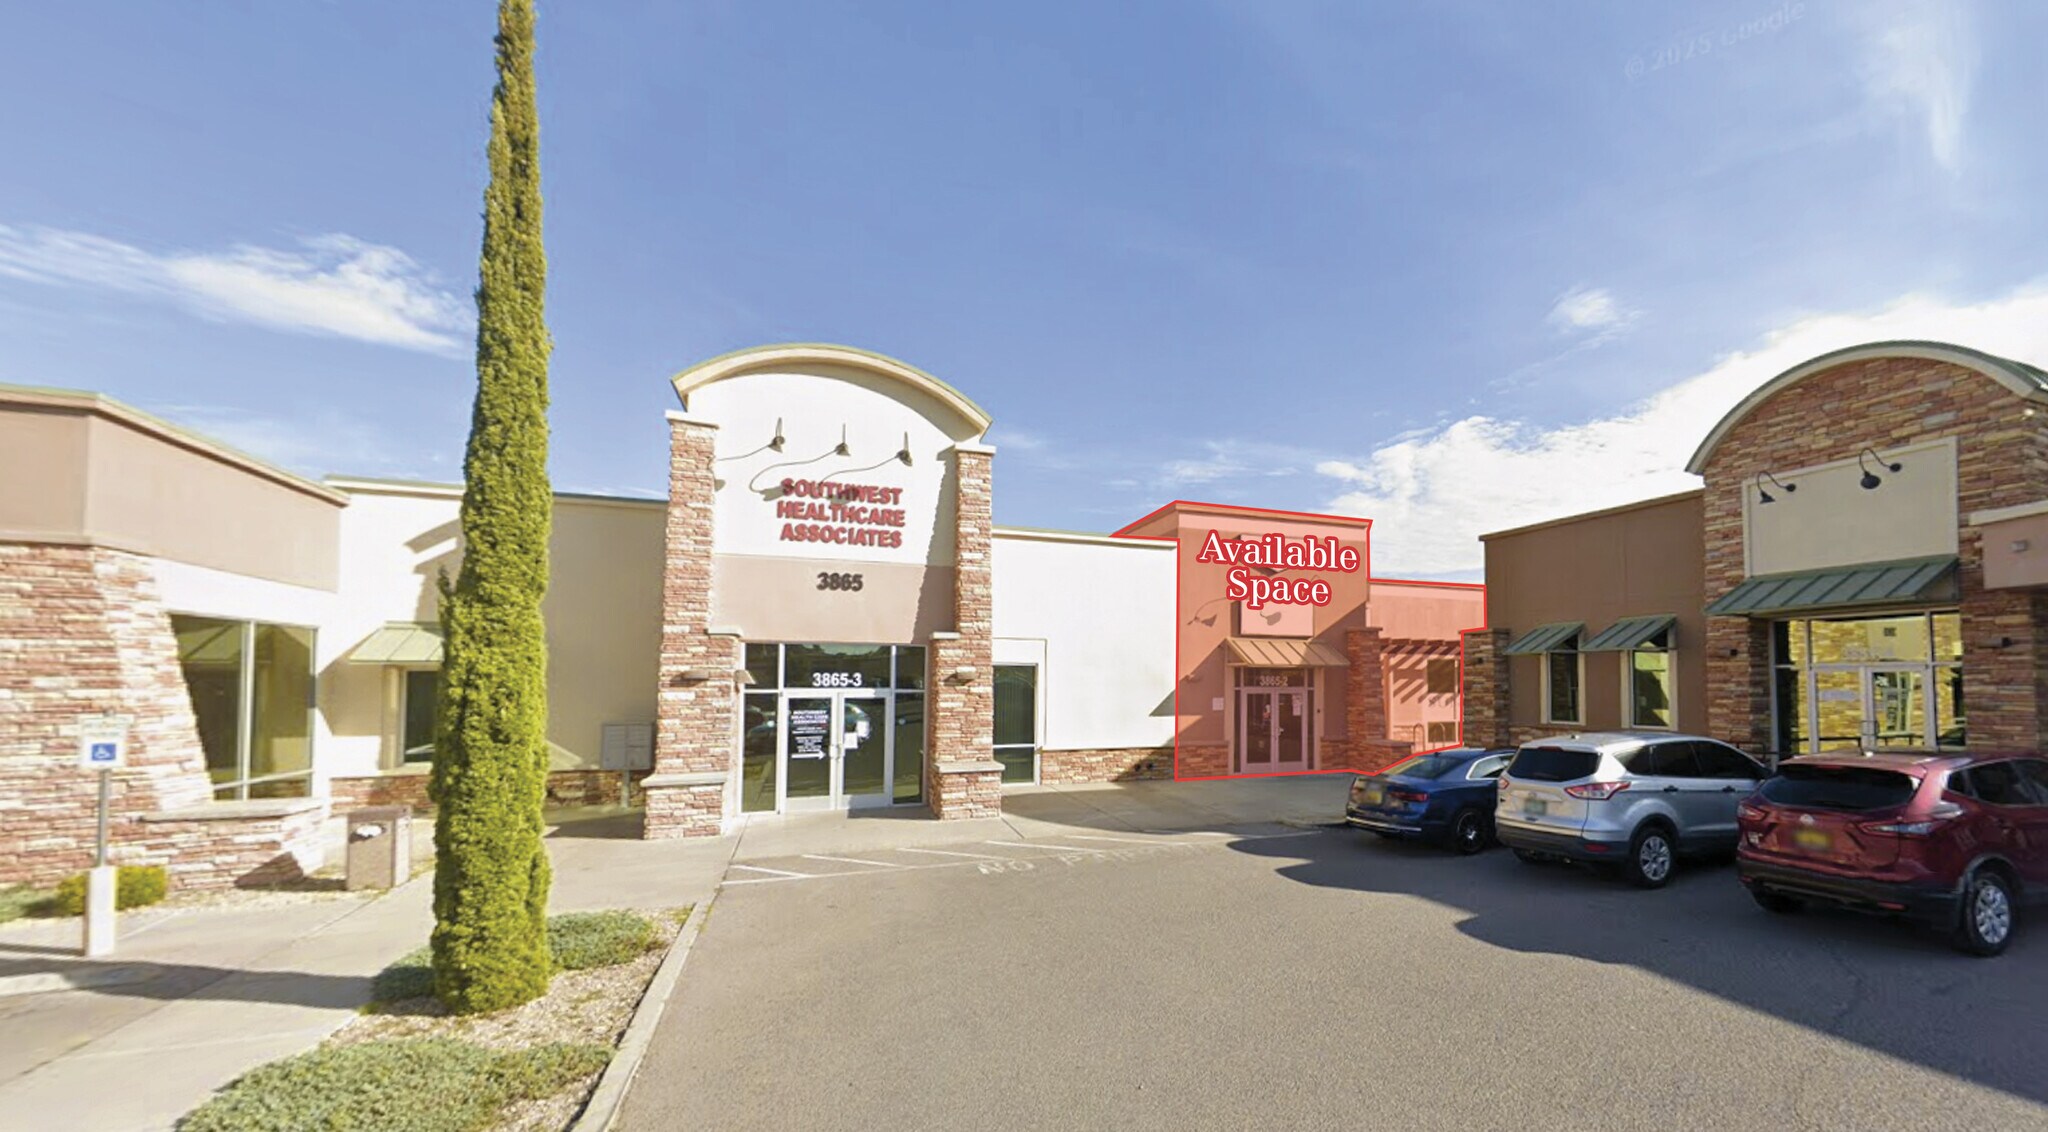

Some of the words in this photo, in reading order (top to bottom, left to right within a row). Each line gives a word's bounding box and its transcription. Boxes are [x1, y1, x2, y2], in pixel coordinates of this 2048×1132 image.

[780, 478, 903, 505] SOUTHWEST
[777, 500, 906, 527] HEALTHCARE
[780, 523, 902, 548] ASSOCIATES
[816, 572, 863, 592] 3865
[812, 672, 862, 687] 3865-3
